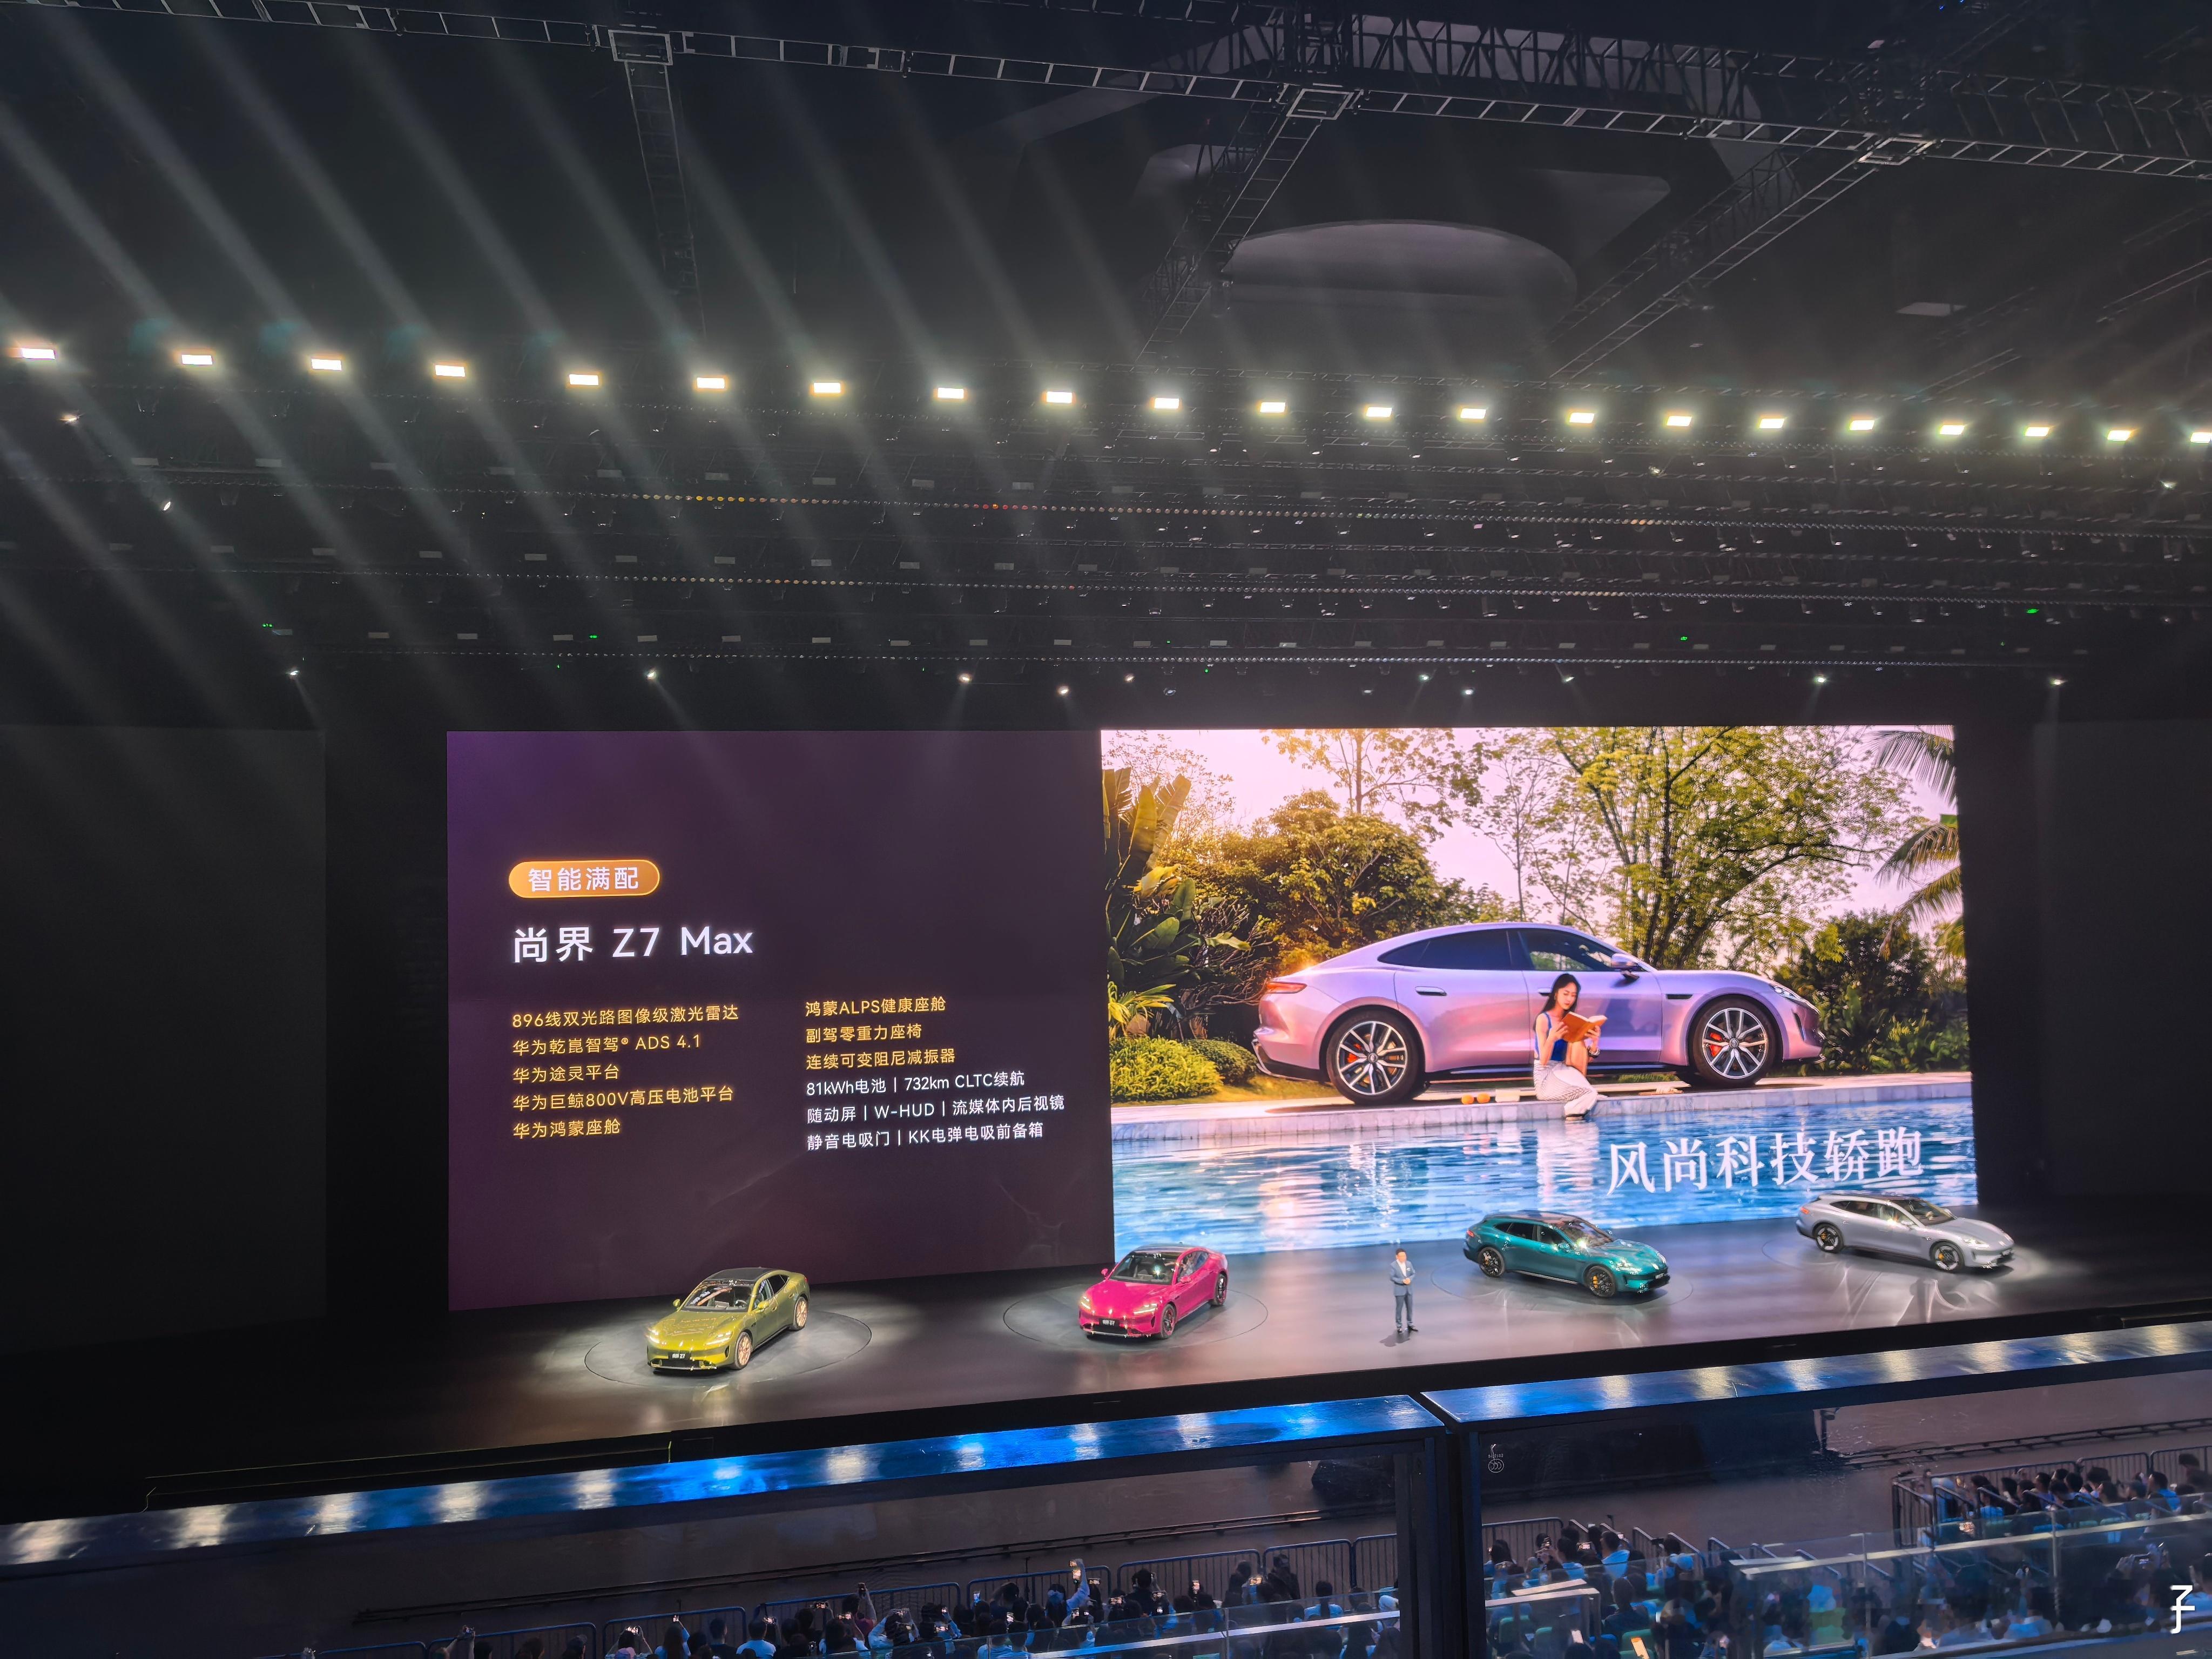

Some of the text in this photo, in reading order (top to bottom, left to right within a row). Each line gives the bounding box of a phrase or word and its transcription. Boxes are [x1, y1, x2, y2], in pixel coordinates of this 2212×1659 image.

[528, 866, 638, 892] 智能满配
[514, 925, 753, 963] 尚界 Z7 Max
[512, 1004, 739, 1028] 896线双光路图像级激光雷达
[805, 996, 946, 1017] 鸿蒙ALPS健康座舱
[635, 1035, 670, 1050] ADS
[677, 1034, 699, 1048] 4.1
[806, 1023, 922, 1043] 副驾零重力座椅
[806, 1048, 955, 1070] 连续可变阻尼减振器
[512, 1063, 619, 1084] 华为途灵平台
[806, 1077, 886, 1096] 81kWh电池
[904, 1076, 949, 1091] 732km
[955, 1070, 1024, 1088] CLTC续航
[512, 1084, 733, 1111] 华为巨鲸800V高压电池平台
[807, 1106, 857, 1124] 随动屏
[874, 1103, 935, 1120] W-HUD
[952, 1094, 1064, 1116] 流媒体内后视镜
[513, 1118, 621, 1139] 华为鸿蒙座舱
[806, 1131, 889, 1151] 静音电吸门
[909, 1121, 1043, 1144] KK电弹电吸前备箱
[1607, 1127, 1924, 1195] 风尚科技轿跑
